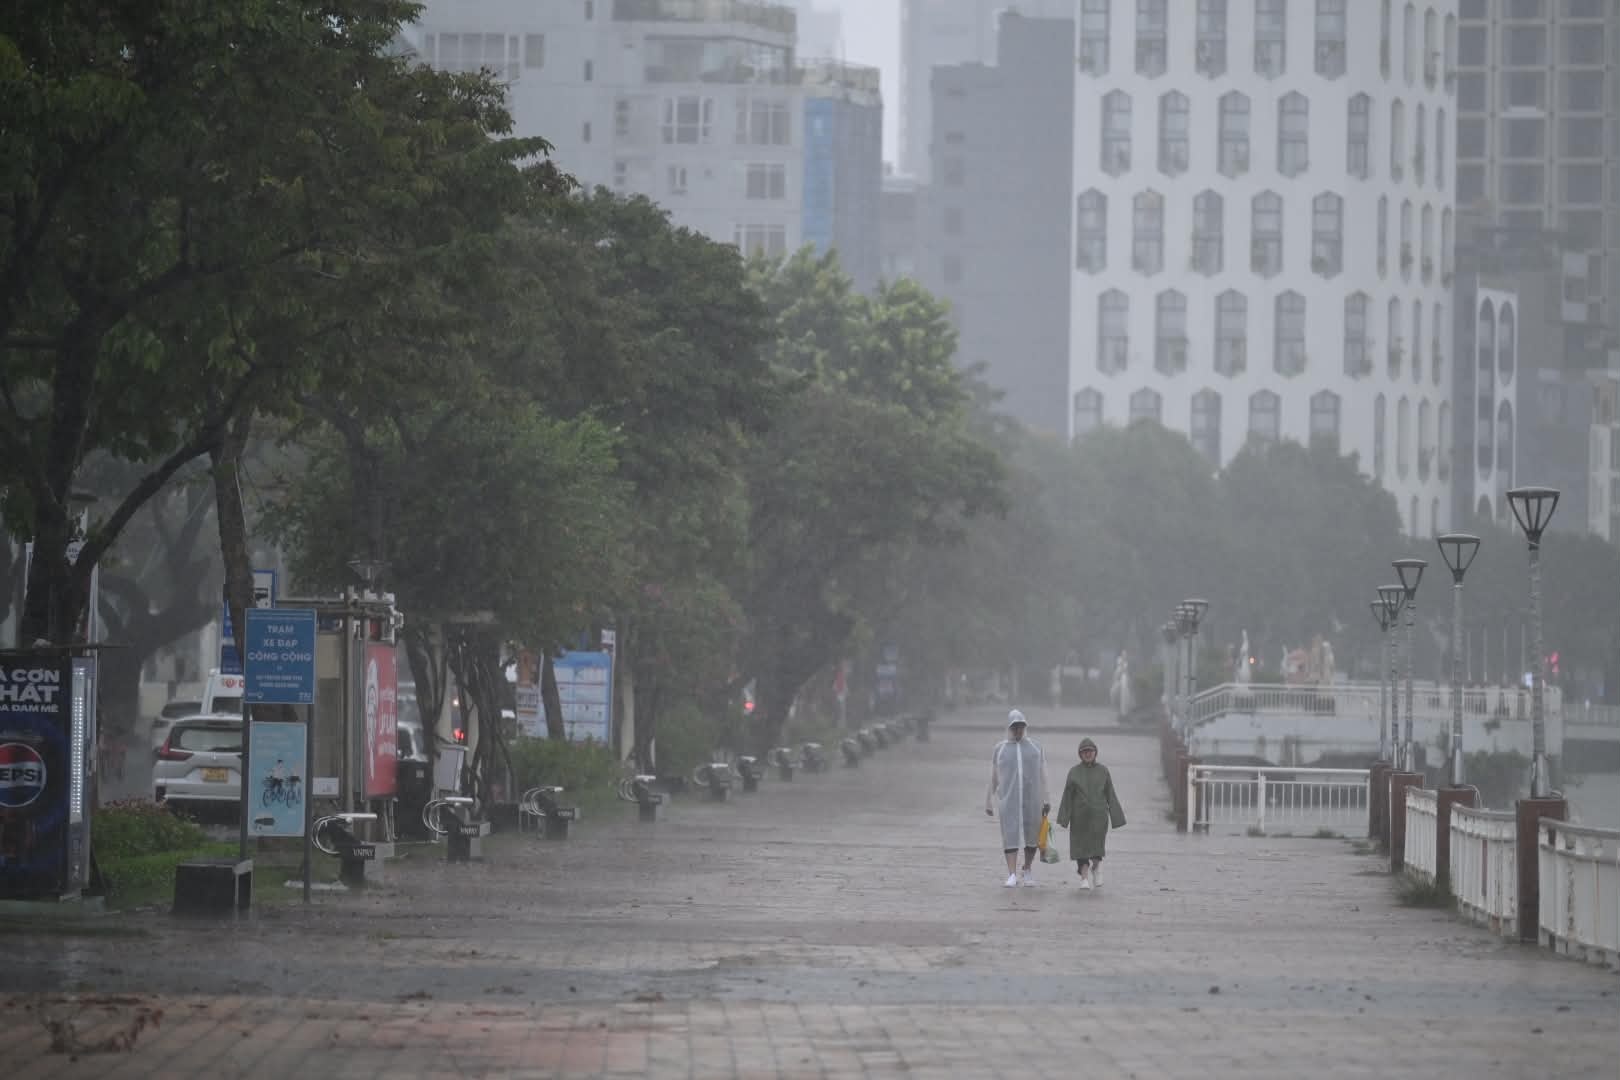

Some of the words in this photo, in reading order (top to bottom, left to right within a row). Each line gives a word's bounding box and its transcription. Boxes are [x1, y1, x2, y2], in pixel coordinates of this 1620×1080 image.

[263, 639, 275, 648] XE
[247, 650, 279, 661] CÔNG
[280, 650, 312, 664] CỘNG
[353, 848, 374, 857] VNPAY
